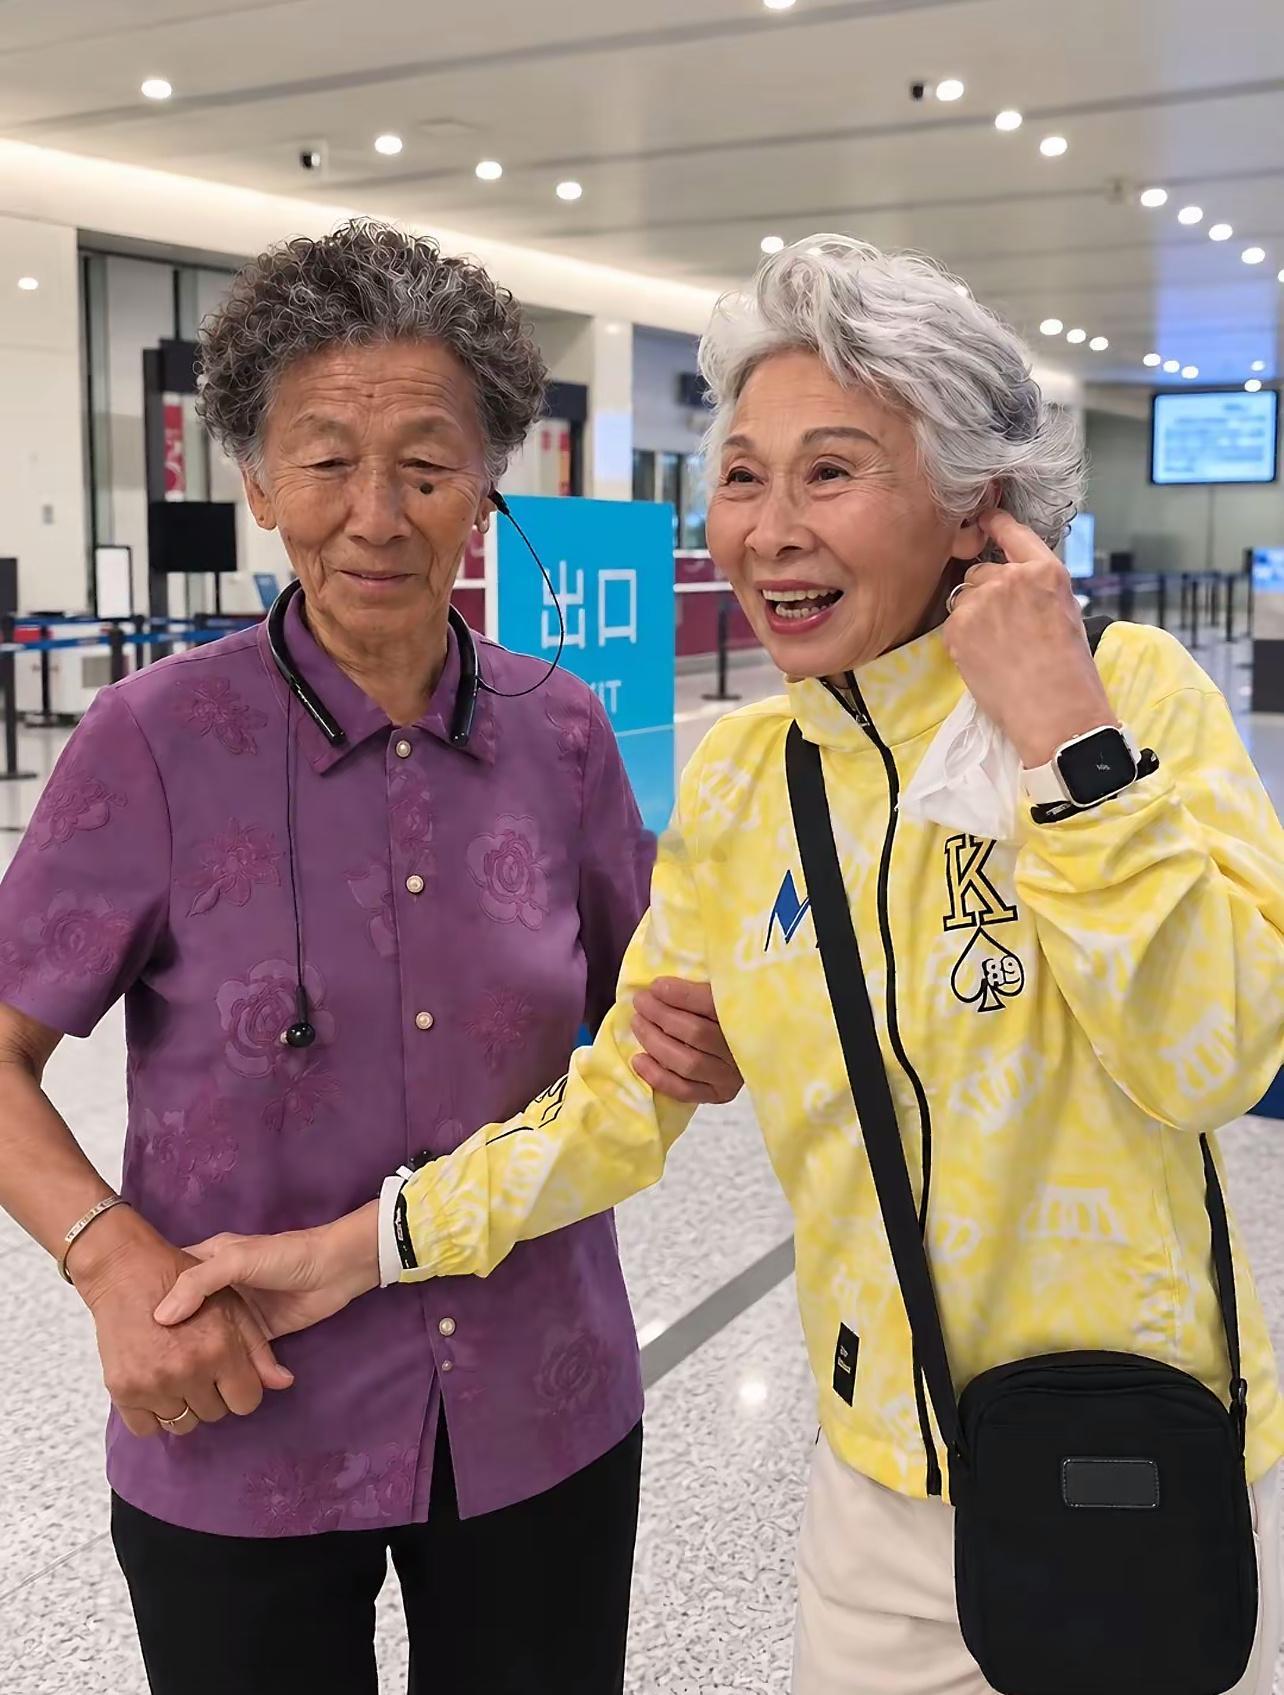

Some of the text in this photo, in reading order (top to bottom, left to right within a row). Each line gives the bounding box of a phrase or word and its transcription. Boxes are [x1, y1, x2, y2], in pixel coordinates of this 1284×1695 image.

[541, 560, 638, 649] 出口
[590, 680, 622, 713] IT
[943, 833, 1018, 931] K
